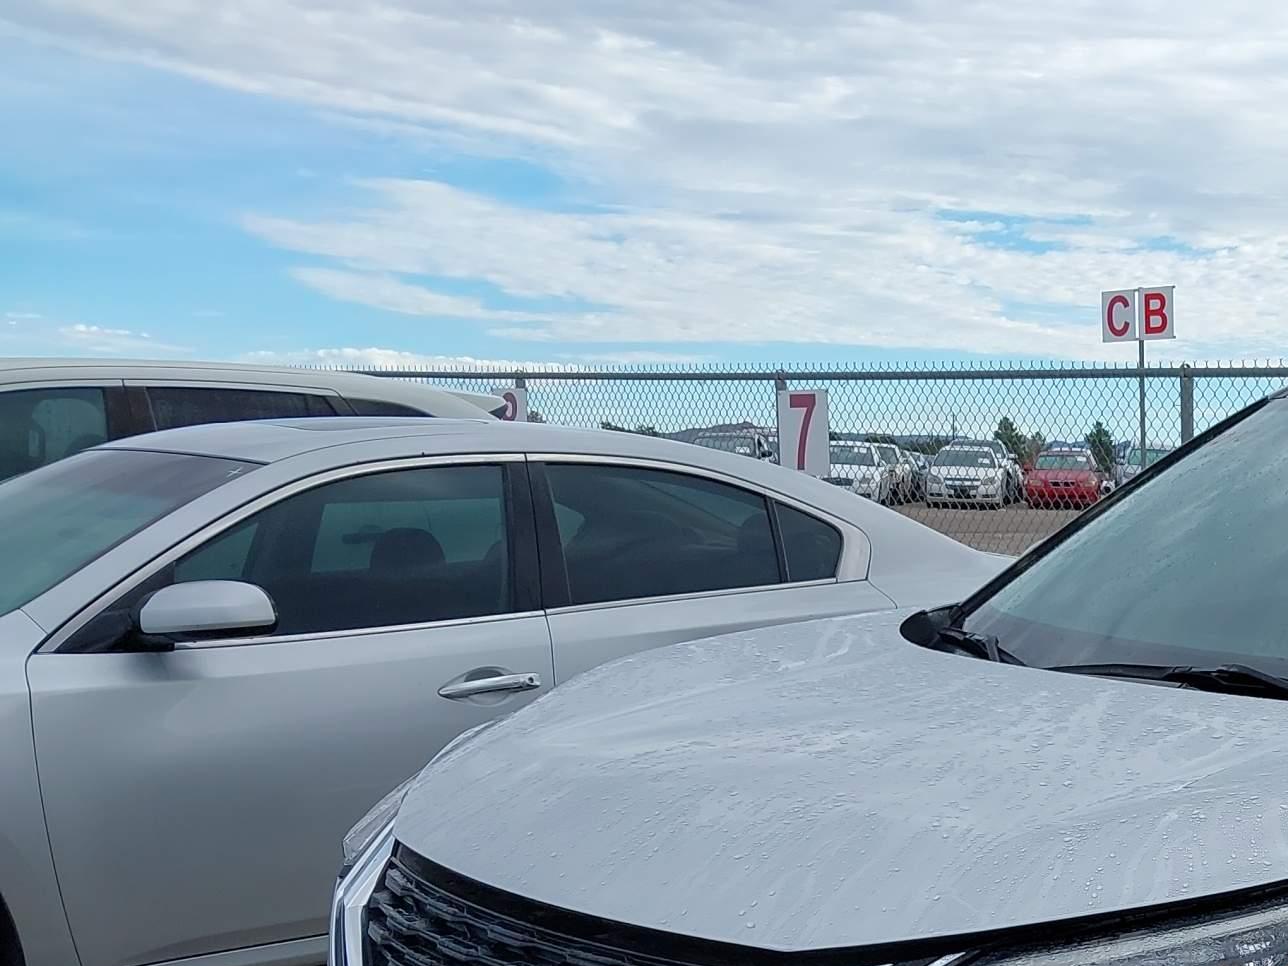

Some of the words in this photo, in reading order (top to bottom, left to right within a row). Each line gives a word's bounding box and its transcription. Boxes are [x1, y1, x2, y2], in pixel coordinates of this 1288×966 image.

[1107, 294, 1130, 337] C
[1144, 292, 1168, 335] B
[789, 393, 816, 471] 7
